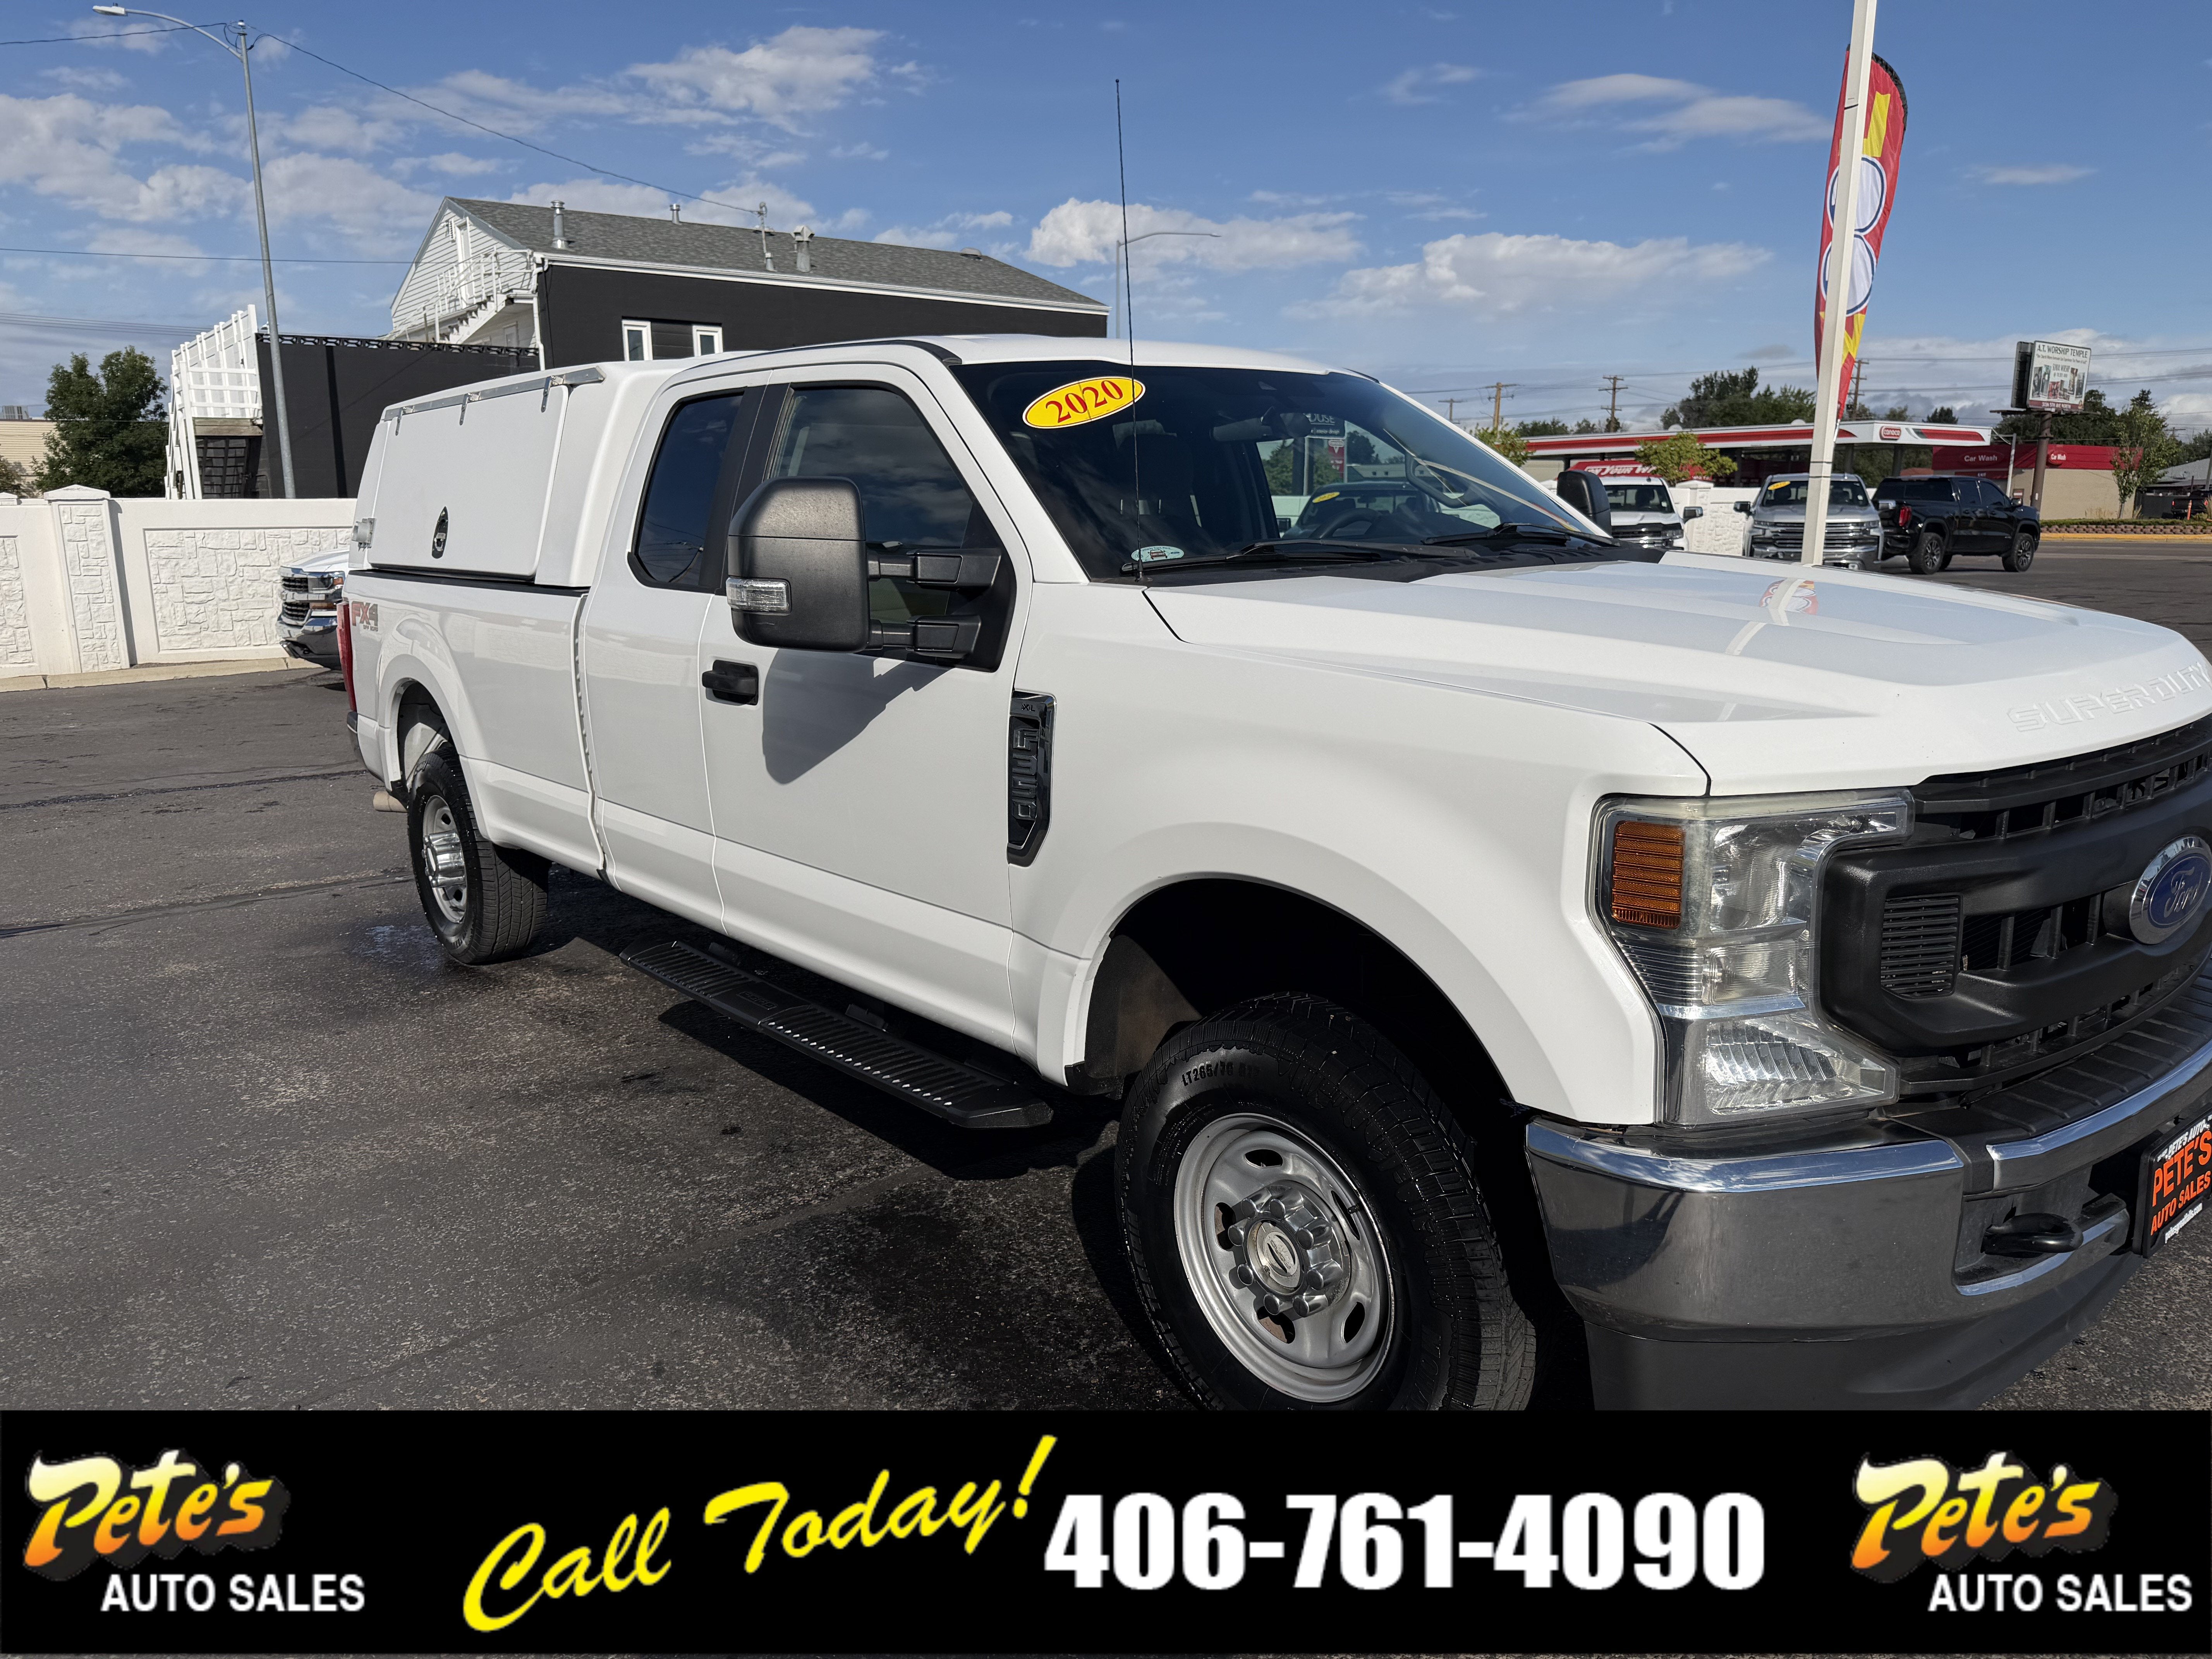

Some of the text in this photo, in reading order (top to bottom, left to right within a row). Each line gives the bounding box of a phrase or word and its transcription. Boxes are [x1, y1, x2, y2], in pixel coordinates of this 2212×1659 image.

[2047, 345, 2069, 355] WORSHIP
[2070, 349, 2088, 358] TEMPLE
[1045, 380, 1123, 423] 2020
[351, 600, 378, 627] FX4
[2007, 683, 2156, 732] SUPER
[2163, 866, 2203, 918] Ford
[2188, 1119, 2206, 1142] AUTO
[2152, 1130, 2212, 1207] PETE'S
[2150, 1170, 2211, 1236] AUTO SALES
